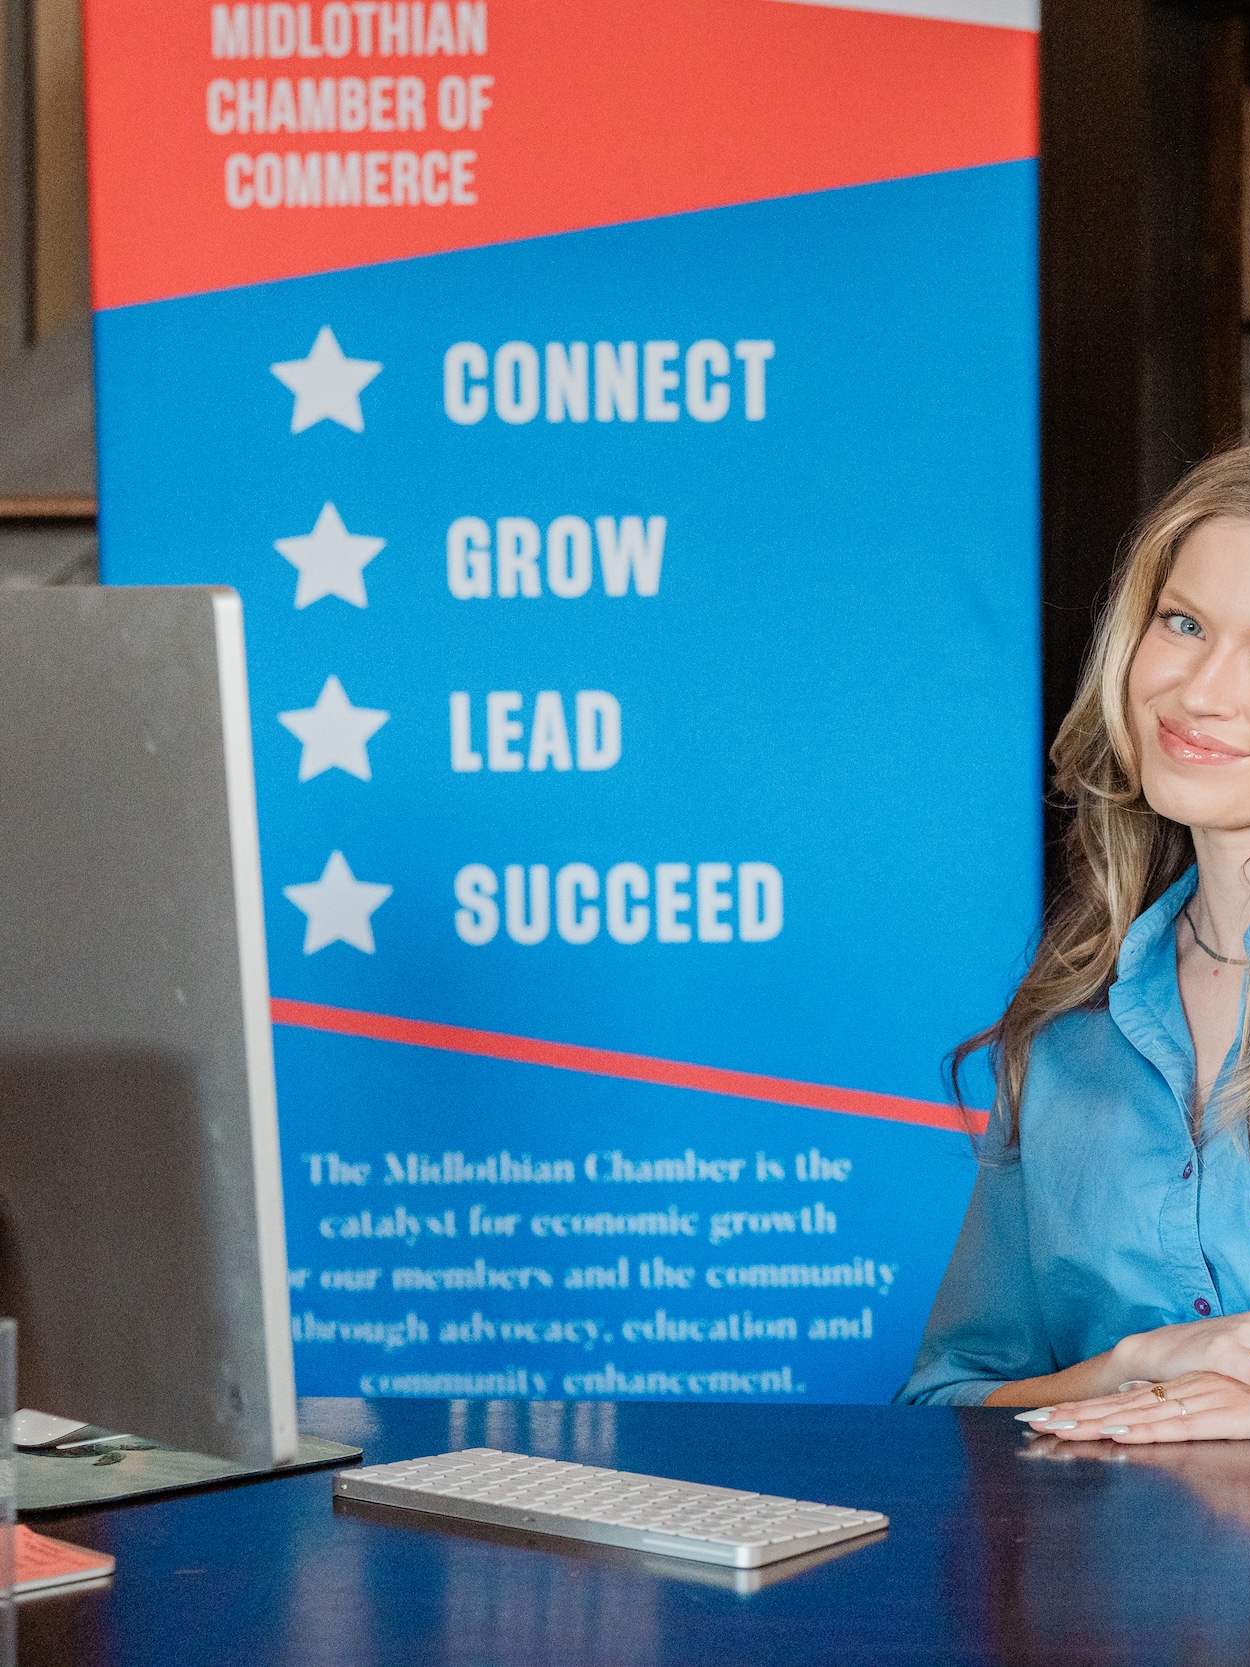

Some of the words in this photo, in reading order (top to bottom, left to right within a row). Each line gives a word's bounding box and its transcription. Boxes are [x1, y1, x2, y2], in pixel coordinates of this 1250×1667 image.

[211, 1, 489, 59] MIDLOTHIAN
[206, 75, 426, 134] CHAMBER
[437, 75, 495, 131] OF
[225, 150, 478, 209] COMMERCE
[443, 339, 775, 426] CONNECT
[446, 515, 667, 599] GROW
[449, 688, 622, 773] LEAD
[453, 861, 784, 946] SUCCEED
[302, 1152, 371, 1185] The
[384, 1150, 576, 1185] Midlothian
[584, 1148, 747, 1183] Chamber
[755, 1150, 786, 1182] is
[795, 1148, 852, 1183] the
[319, 1204, 457, 1247] catalyst
[468, 1204, 521, 1237] for
[531, 1205, 699, 1237] economic
[709, 1202, 838, 1246] growth
[320, 1267, 382, 1291] our
[391, 1258, 554, 1290] members
[564, 1255, 630, 1290] and
[639, 1256, 696, 1290] the
[705, 1256, 900, 1297] community
[291, 1311, 429, 1352] through
[621, 1311, 798, 1343] education
[807, 1307, 873, 1341] and
[359, 1365, 548, 1400] community
[562, 1362, 807, 1396] enhancement.
